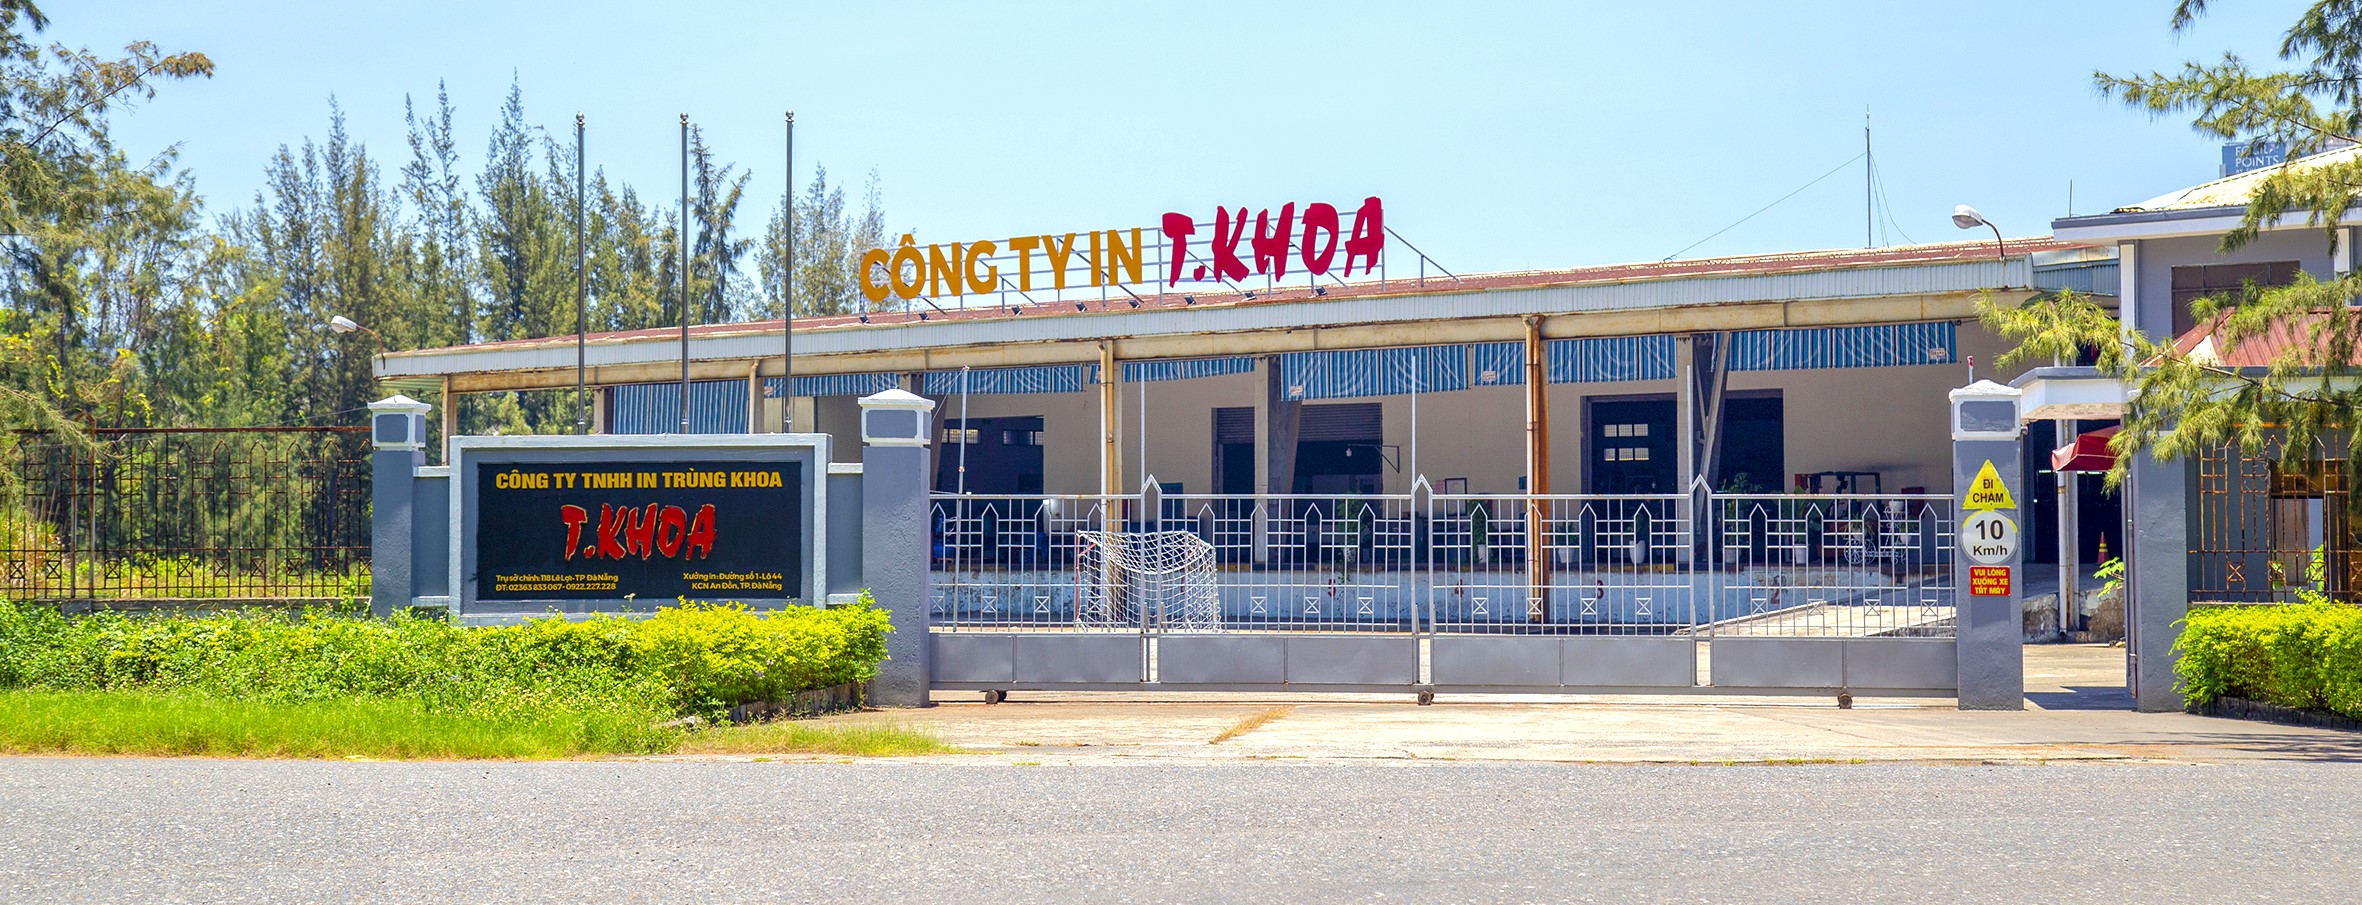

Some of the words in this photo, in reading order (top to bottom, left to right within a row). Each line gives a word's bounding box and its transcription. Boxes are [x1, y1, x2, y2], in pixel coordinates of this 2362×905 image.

[2235, 155, 2279, 168] POINTS
[859, 233, 997, 301] CÔNG
[1009, 232, 1077, 292] TY
[1090, 227, 1143, 287] IN
[1162, 196, 1385, 288] T.KHOA
[495, 469, 549, 489] CÔNG
[553, 472, 576, 489] TY
[581, 472, 633, 489] TNHH
[636, 472, 658, 488] IN
[662, 467, 726, 488] TRÙNG
[730, 471, 783, 488] KHOA
[1983, 478, 1994, 489] ĐI
[561, 502, 717, 561] T.KHOA
[1975, 519, 2004, 540] 10
[1973, 545, 2008, 556] Km/h
[1973, 568, 1986, 576] VUI
[691, 582, 709, 590] KCN
[709, 582, 721, 590] An
